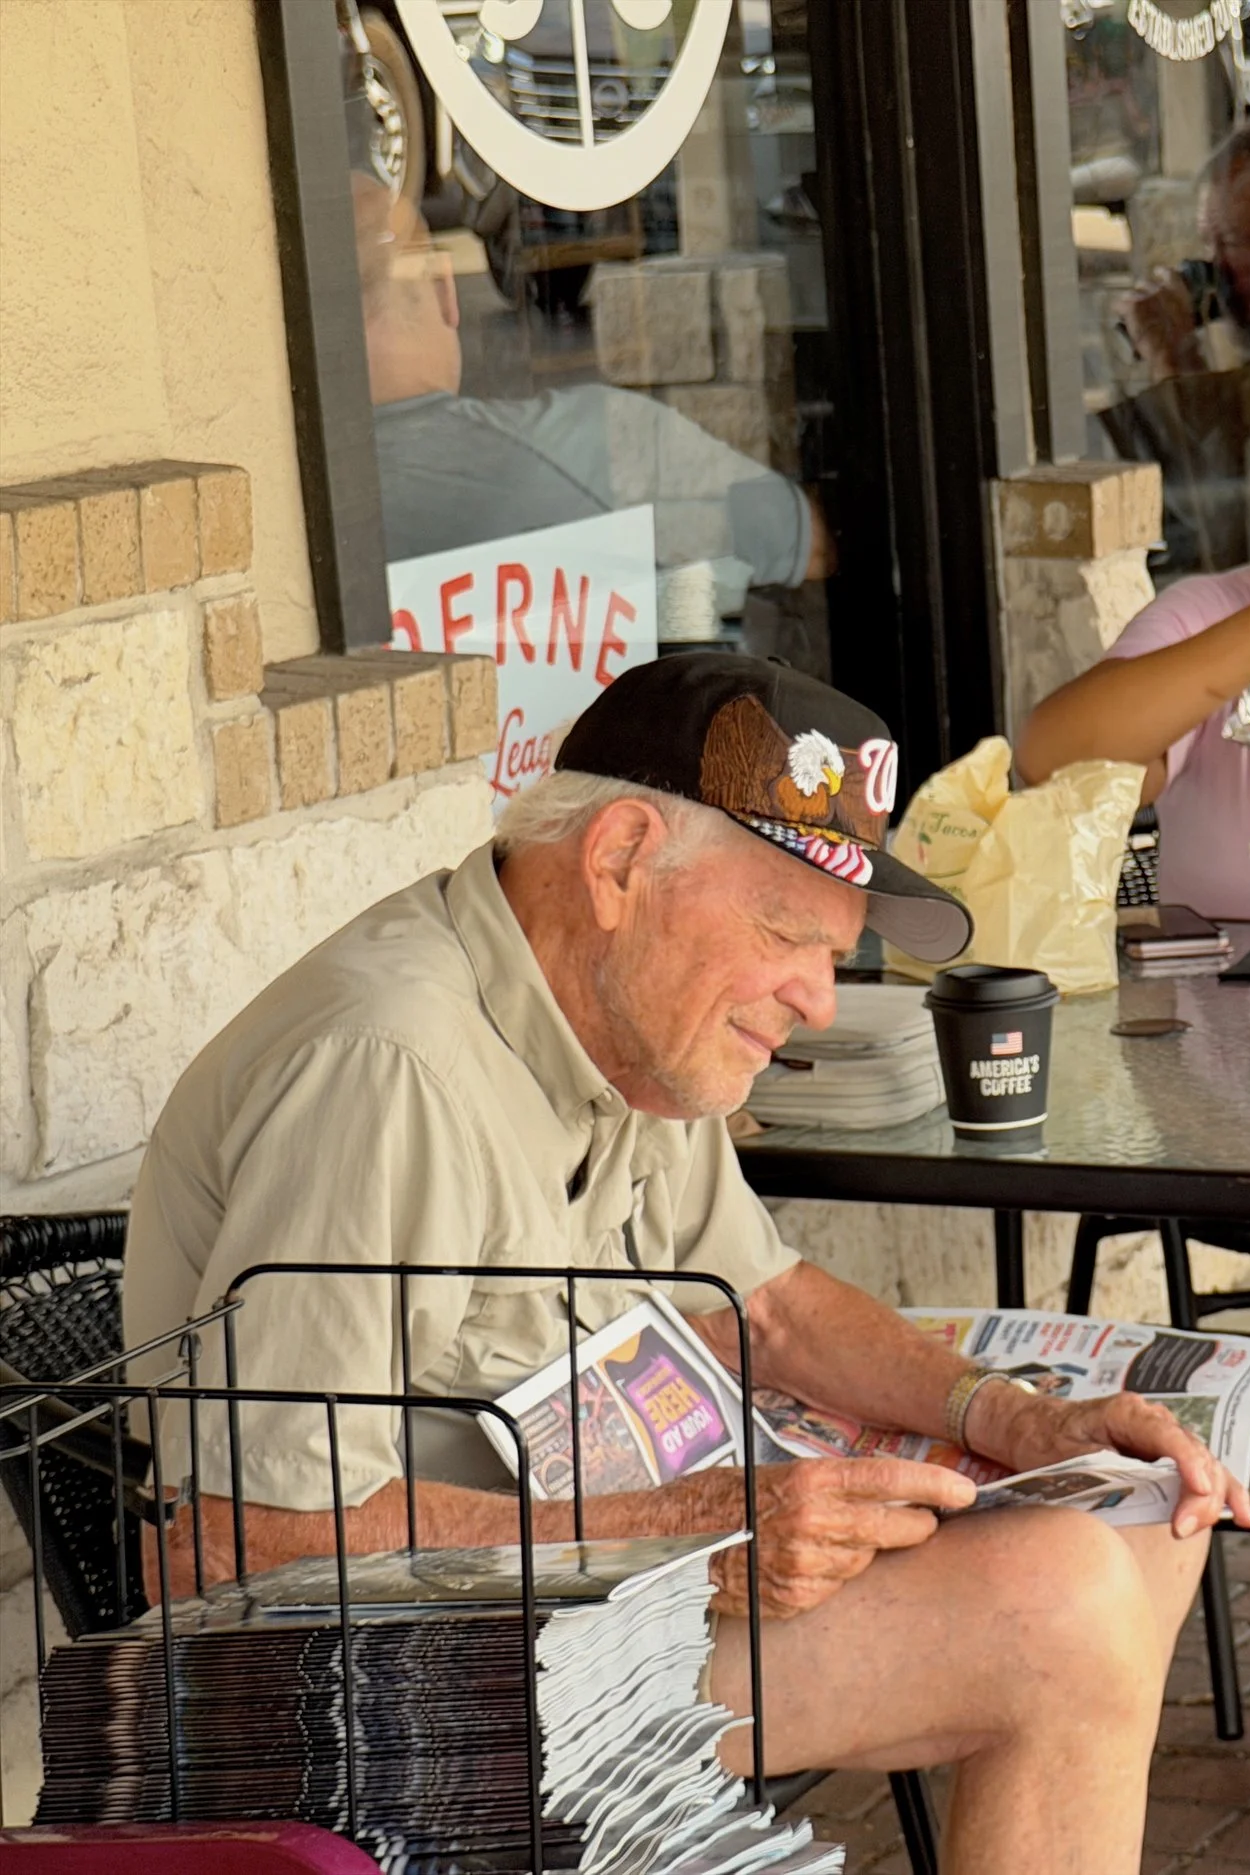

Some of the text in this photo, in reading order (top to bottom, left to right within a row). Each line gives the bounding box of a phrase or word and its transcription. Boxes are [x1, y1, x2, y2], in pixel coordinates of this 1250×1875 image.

[969, 1053, 1041, 1079] AMERICA'S
[979, 1074, 1033, 1097] COFFEE
[645, 1378, 702, 1434] HERE
[660, 1425, 684, 1453] AD
